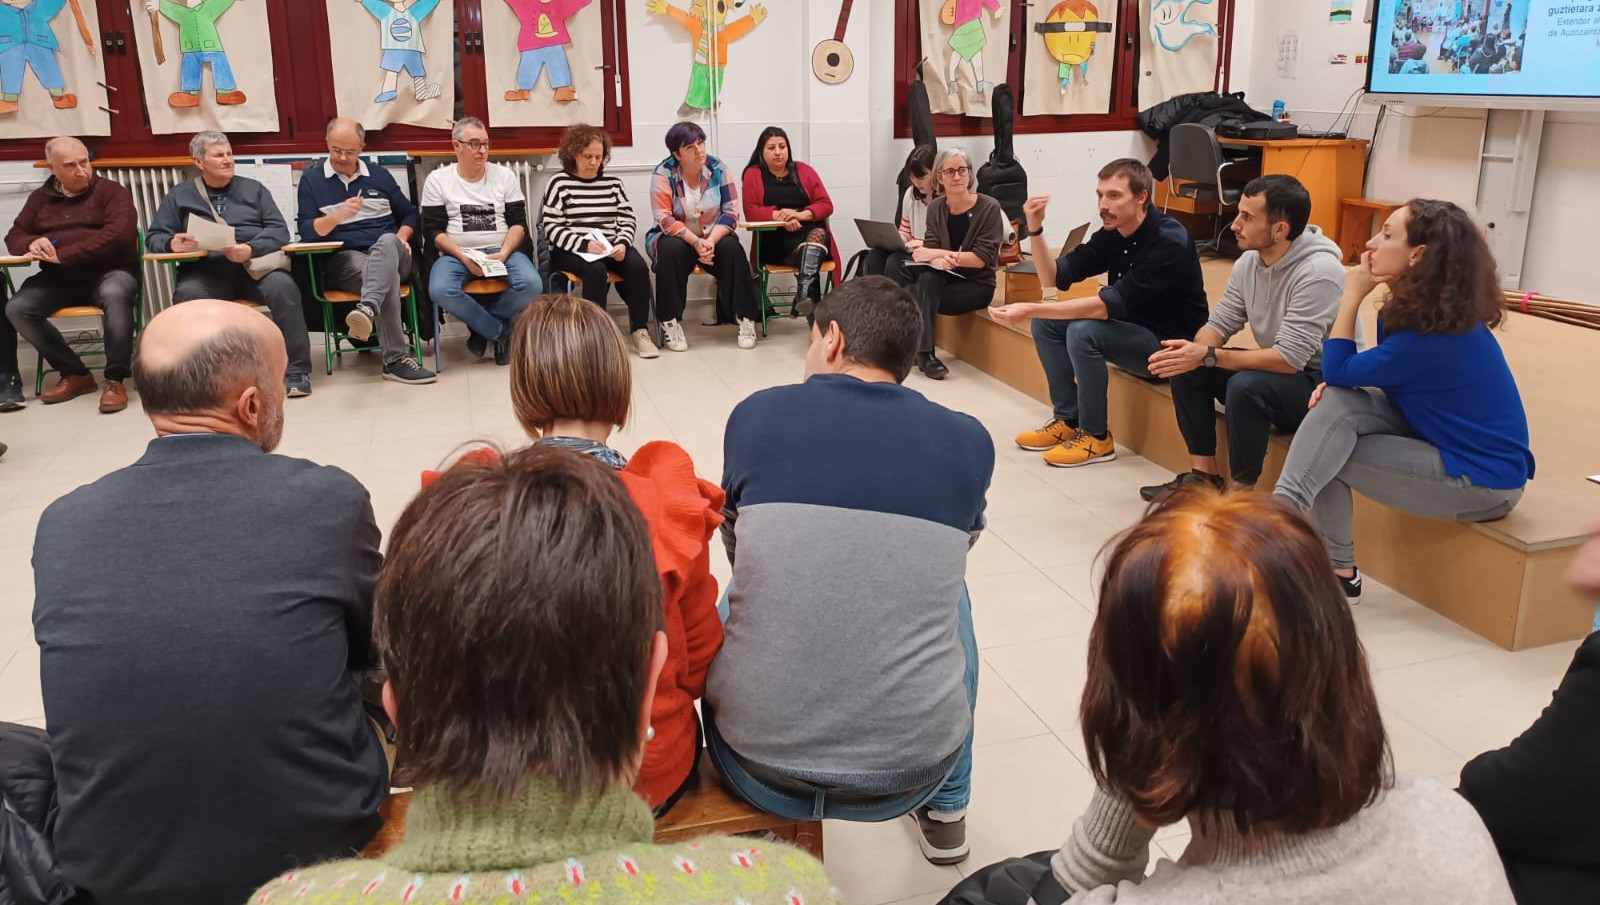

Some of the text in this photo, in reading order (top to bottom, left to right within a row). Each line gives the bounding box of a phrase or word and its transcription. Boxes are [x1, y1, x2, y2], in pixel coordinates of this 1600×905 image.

[1548, 5, 1594, 17] guztietara
[1556, 17, 1590, 26] Extender
[1548, 29, 1557, 37] de
